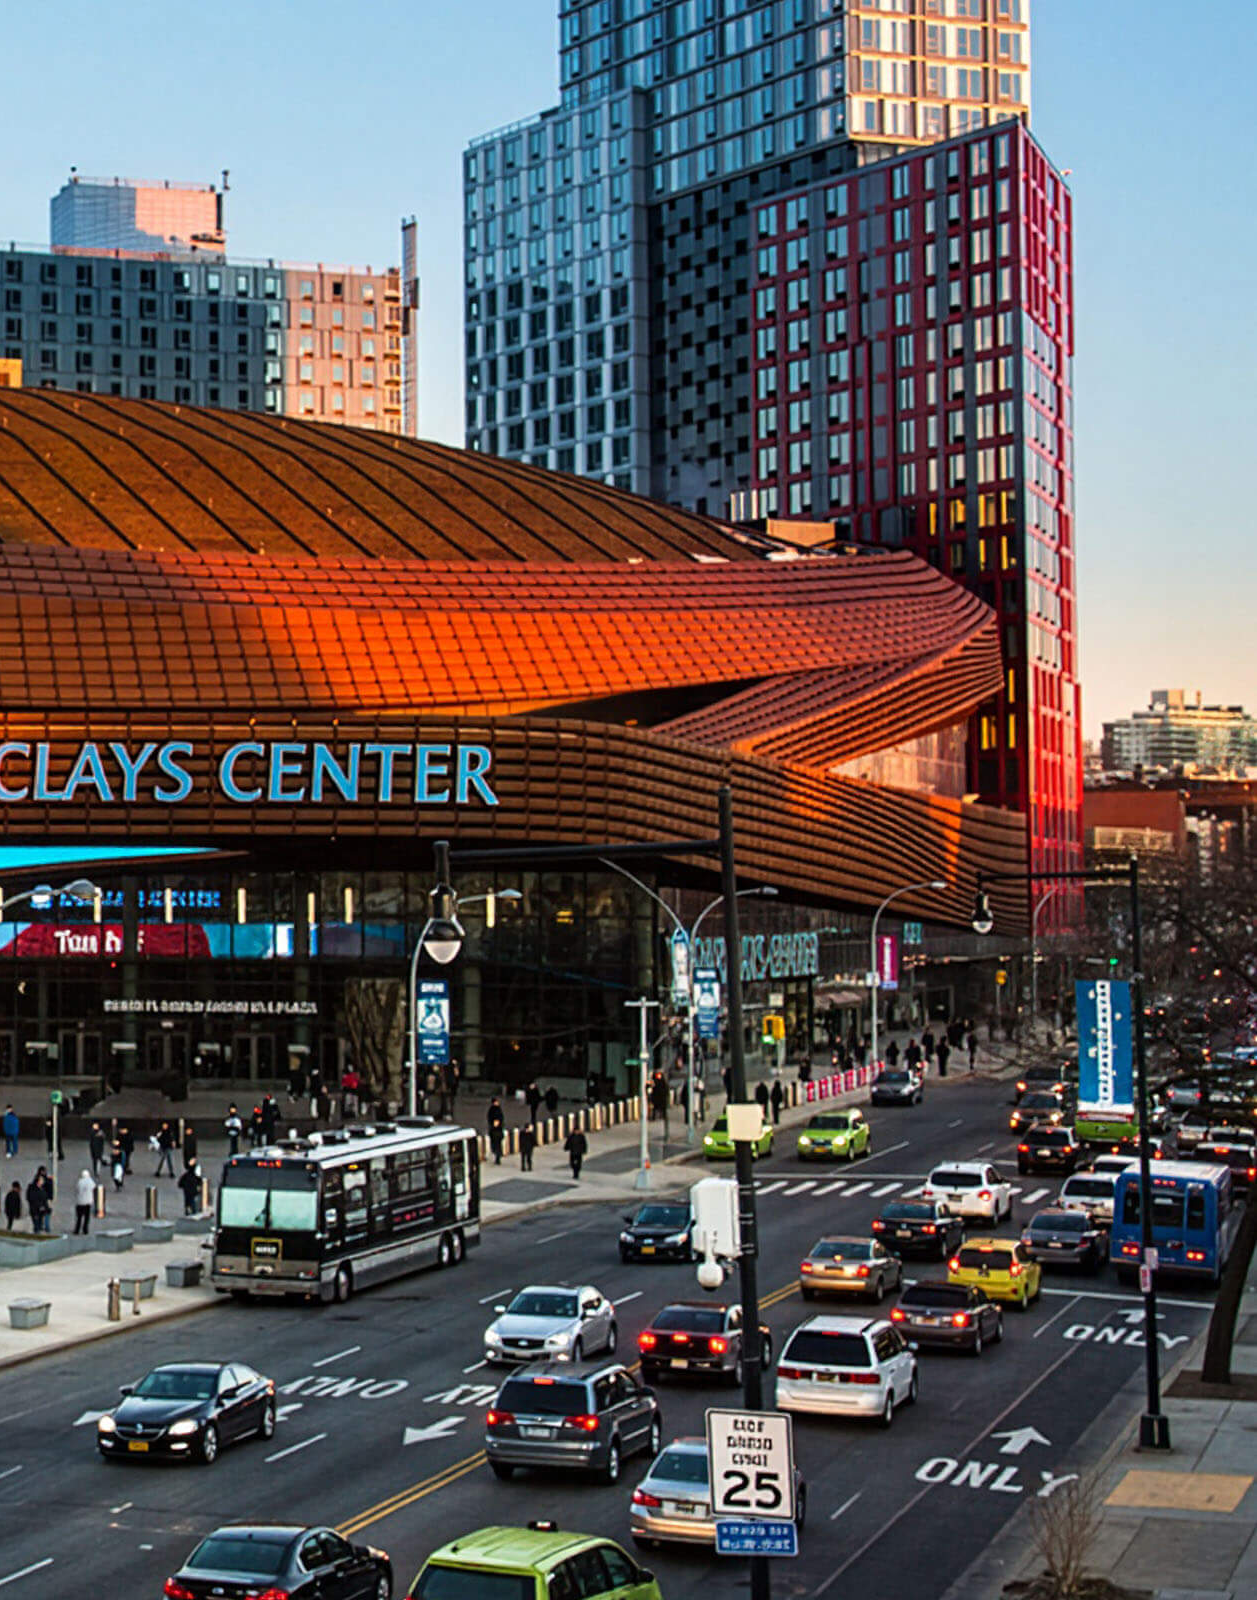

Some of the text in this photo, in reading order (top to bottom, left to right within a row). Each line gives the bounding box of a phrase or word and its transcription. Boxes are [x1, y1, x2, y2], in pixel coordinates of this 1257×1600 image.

[218, 742, 499, 805] CENTER
[1062, 1323, 1190, 1350] ONLY
[723, 1470, 782, 1510] 25
[914, 1457, 1079, 1498] ONLY
